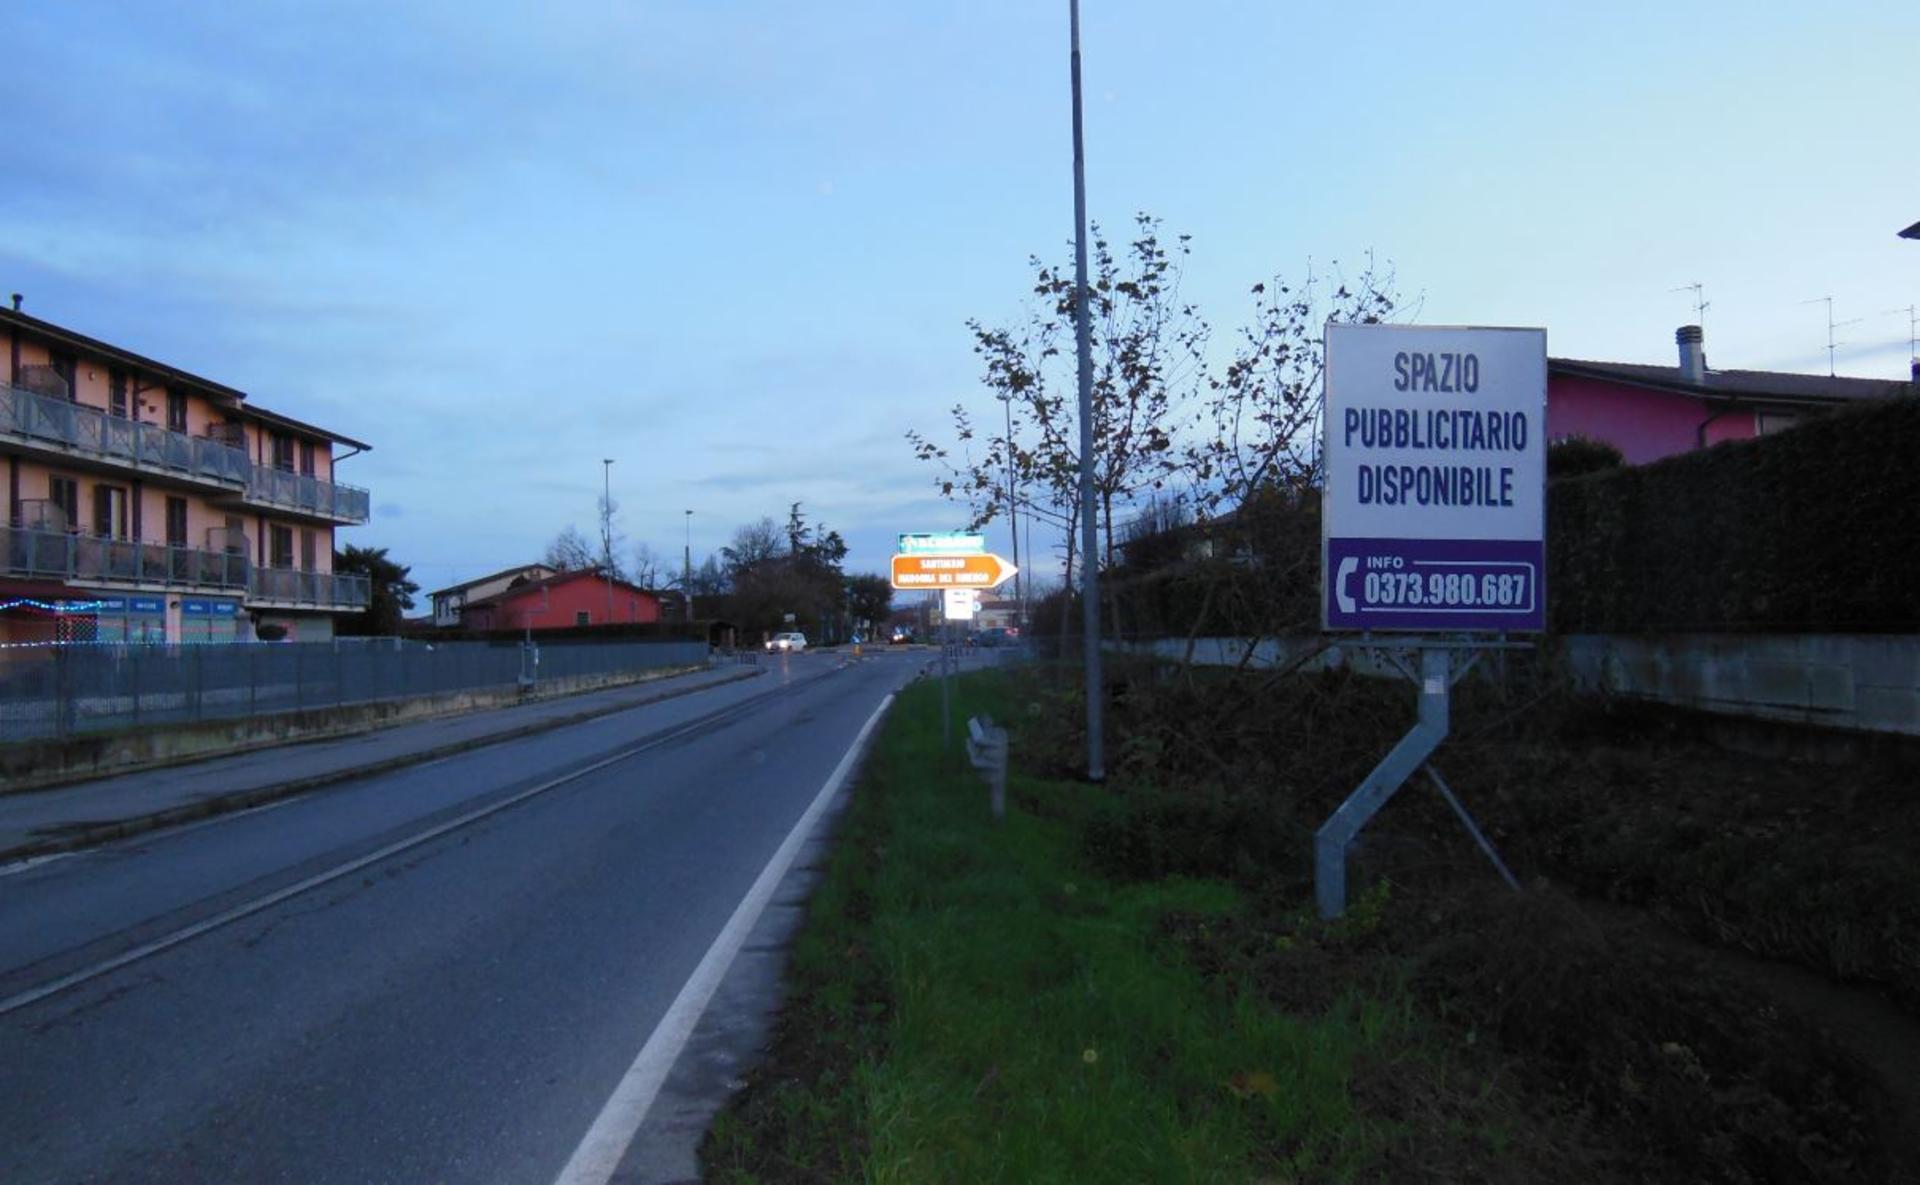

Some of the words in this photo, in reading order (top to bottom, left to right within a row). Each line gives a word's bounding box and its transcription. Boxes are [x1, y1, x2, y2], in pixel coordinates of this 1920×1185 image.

[1393, 351, 1480, 394] SPAZIO
[1344, 407, 1528, 452] PUBBLICITARIO
[1357, 464, 1515, 508] DISPONIBILE
[1366, 556, 1405, 570] INFO
[1364, 572, 1526, 606] 0373.980.687
